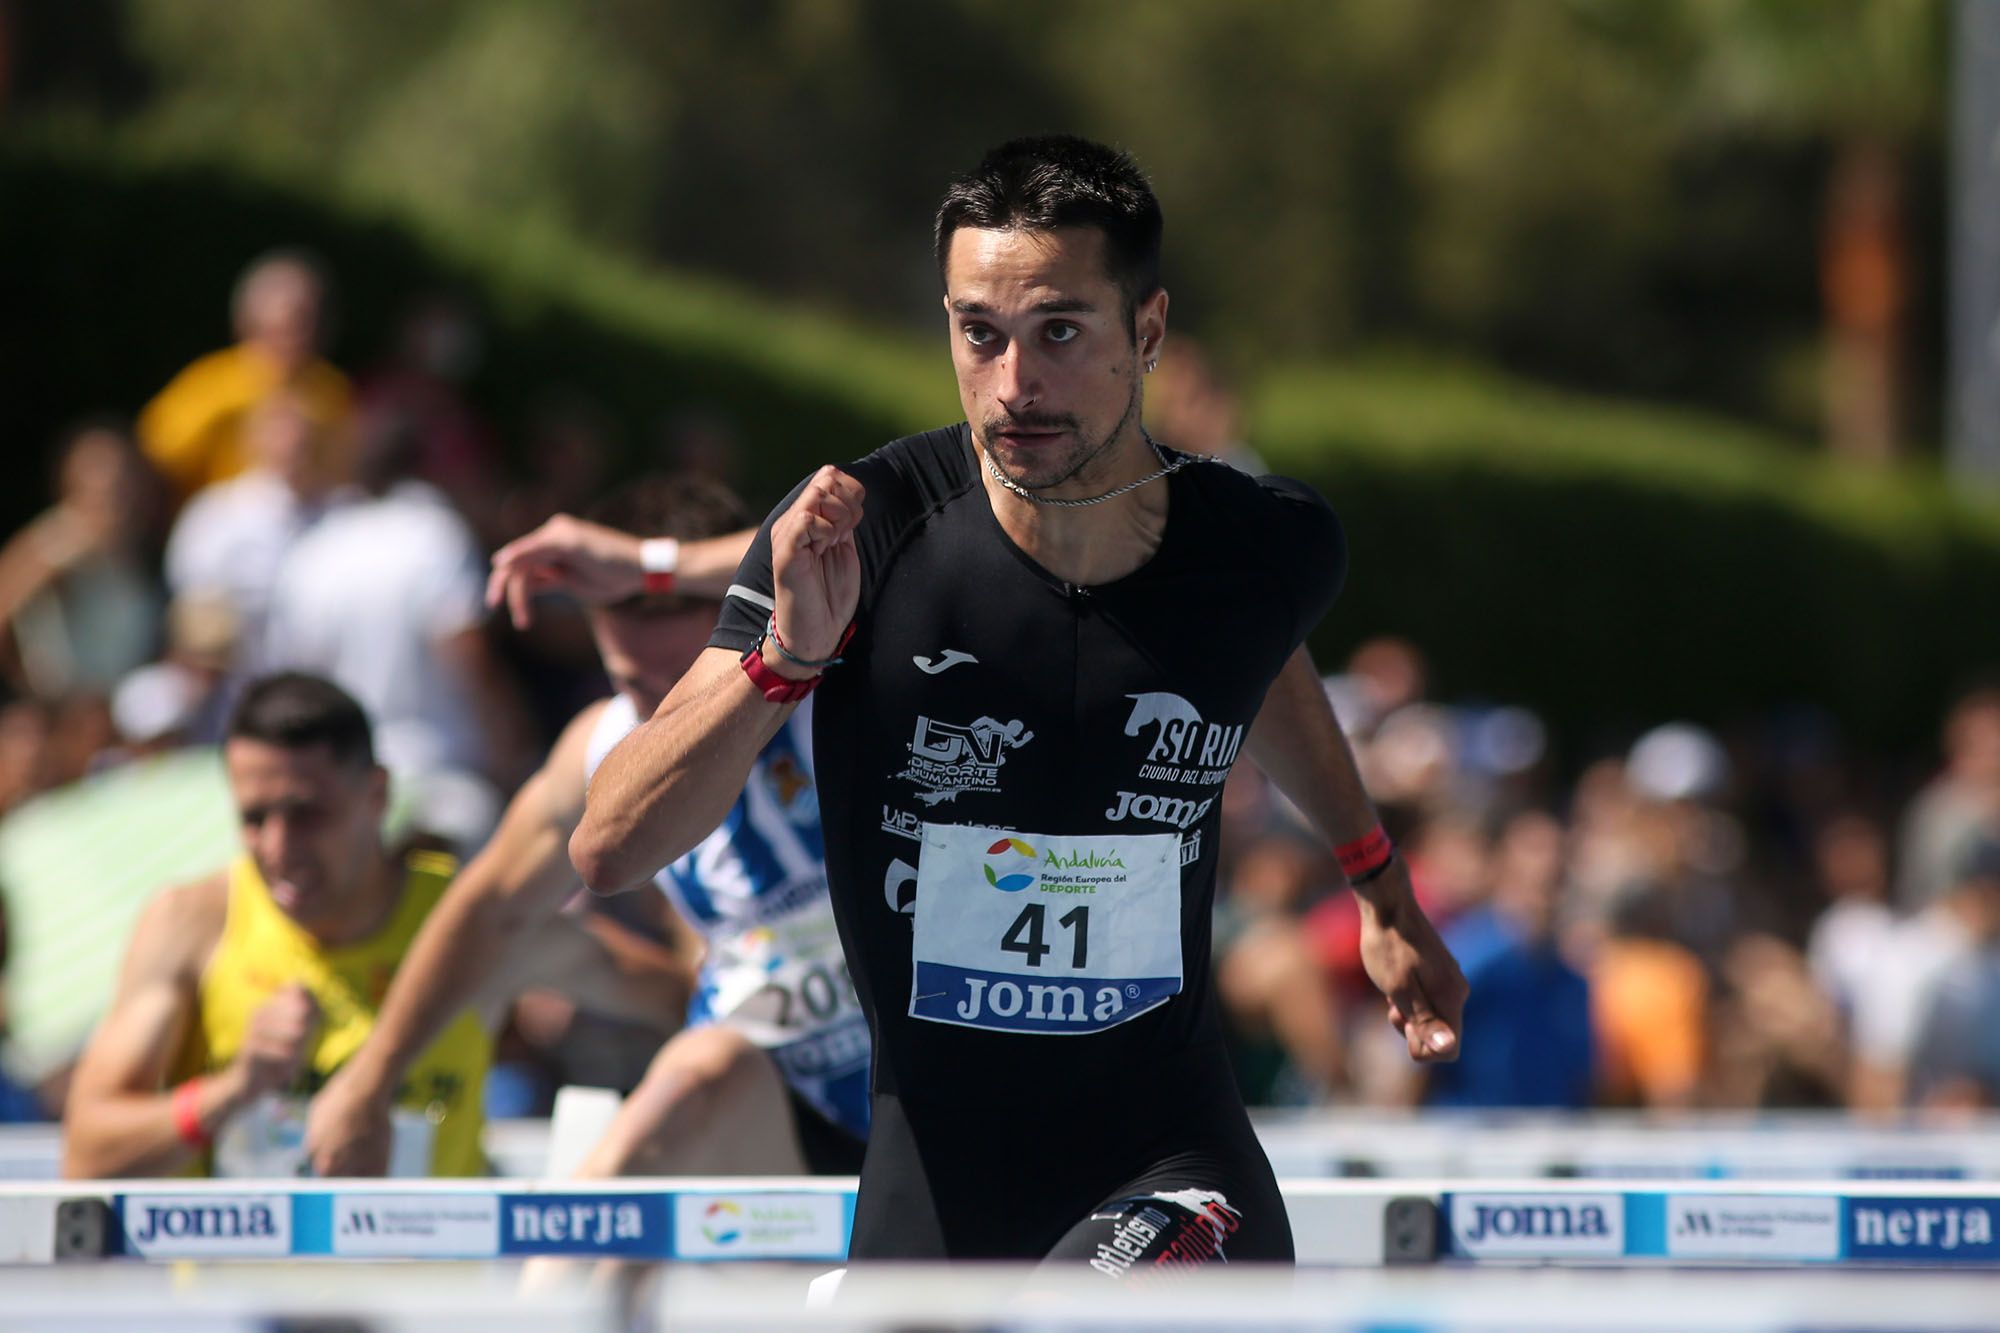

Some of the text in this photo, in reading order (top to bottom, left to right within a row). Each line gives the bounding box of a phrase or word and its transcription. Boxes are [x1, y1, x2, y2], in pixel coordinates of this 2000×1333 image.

[910, 767, 997, 786] NUMANTINO
[911, 756, 999, 778] DEPORTE
[1138, 764, 1180, 784] CIUDAD
[1180, 770, 1200, 785] DEL
[1040, 883, 1097, 894] DEPORTE
[1041, 873, 1127, 885] Región Europea del
[1001, 903, 1090, 969] 41
[511, 1203, 644, 1244] nerja
[1854, 1207, 1994, 1250] nerja
[1089, 1206, 1172, 1280] Atletismo
[1128, 1202, 1240, 1290] mantino
